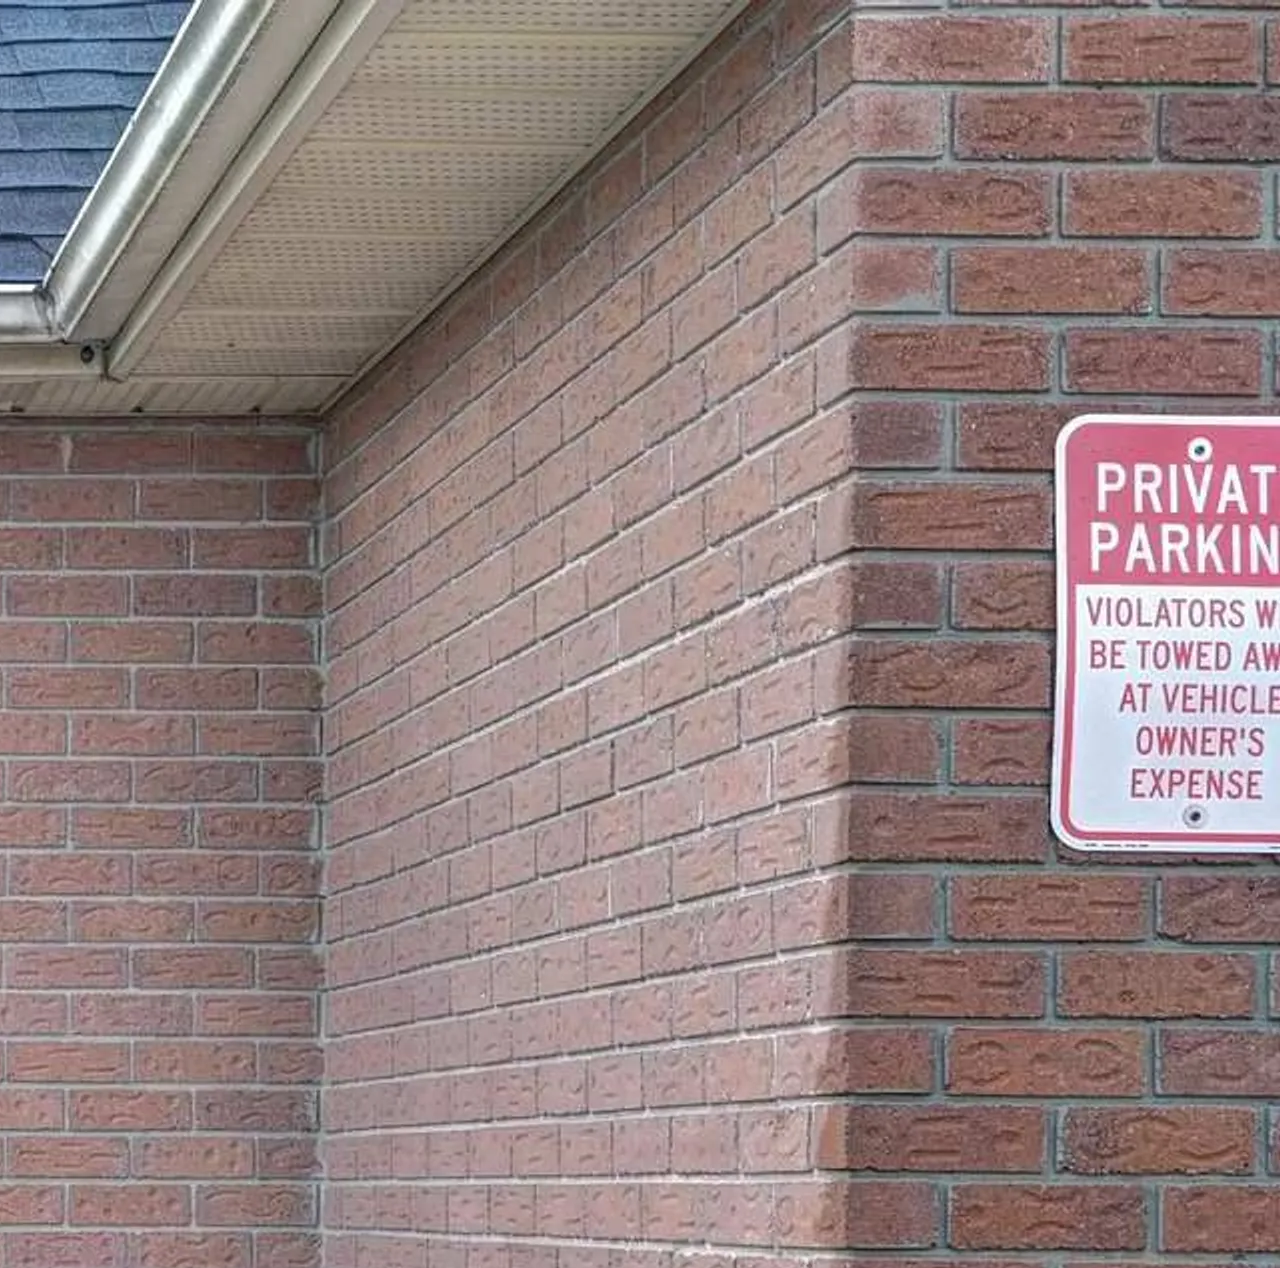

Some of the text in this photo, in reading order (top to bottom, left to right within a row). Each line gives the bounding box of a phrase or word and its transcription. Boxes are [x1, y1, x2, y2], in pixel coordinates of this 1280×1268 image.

[1096, 462, 1277, 515] PRIVAT
[1089, 522, 1280, 576] PARKIN
[1086, 596, 1246, 629] VIOLATORS
[1089, 639, 1126, 671] BE
[1136, 640, 1232, 672] TOWED
[1119, 683, 1149, 714] AT
[1136, 726, 1265, 758] OWNER'S
[1130, 768, 1264, 801] EXPENSE
